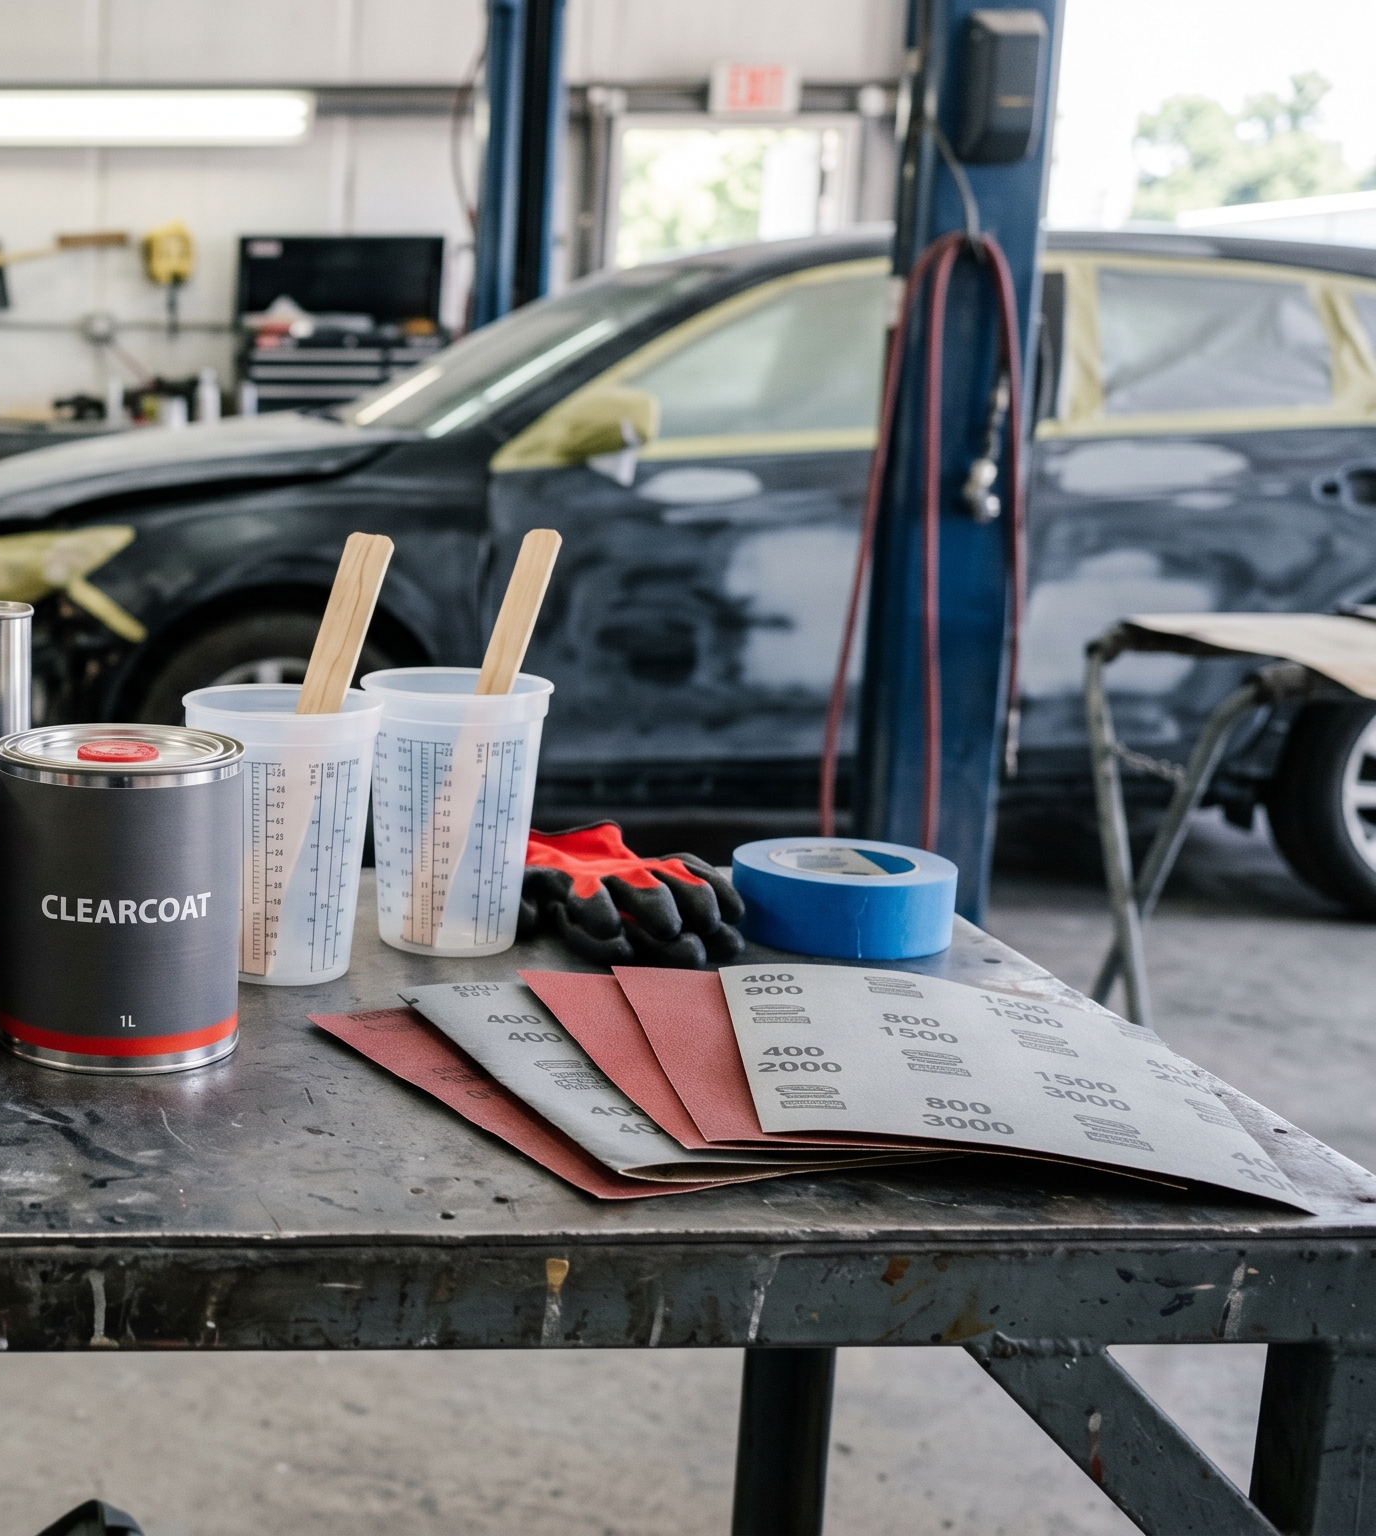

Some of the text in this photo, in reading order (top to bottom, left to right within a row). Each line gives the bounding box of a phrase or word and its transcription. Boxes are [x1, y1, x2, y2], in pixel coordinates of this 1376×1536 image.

[41, 892, 211, 924] CLEARCOAT
[741, 973, 795, 983] 400
[744, 986, 803, 996] 900
[980, 995, 1050, 1015] 1500
[119, 1015, 136, 1028] 1L
[487, 1014, 542, 1025] 400
[882, 1013, 941, 1028] 800
[986, 1007, 1064, 1029] 1500
[508, 1032, 563, 1043] 400
[878, 1026, 959, 1044] 1500
[762, 1046, 825, 1057] 400
[757, 1061, 842, 1073] 2000
[1034, 1071, 1117, 1094] 1500
[925, 1097, 992, 1115] 800
[1042, 1086, 1131, 1112] 3000
[922, 1114, 1015, 1135] 3000
